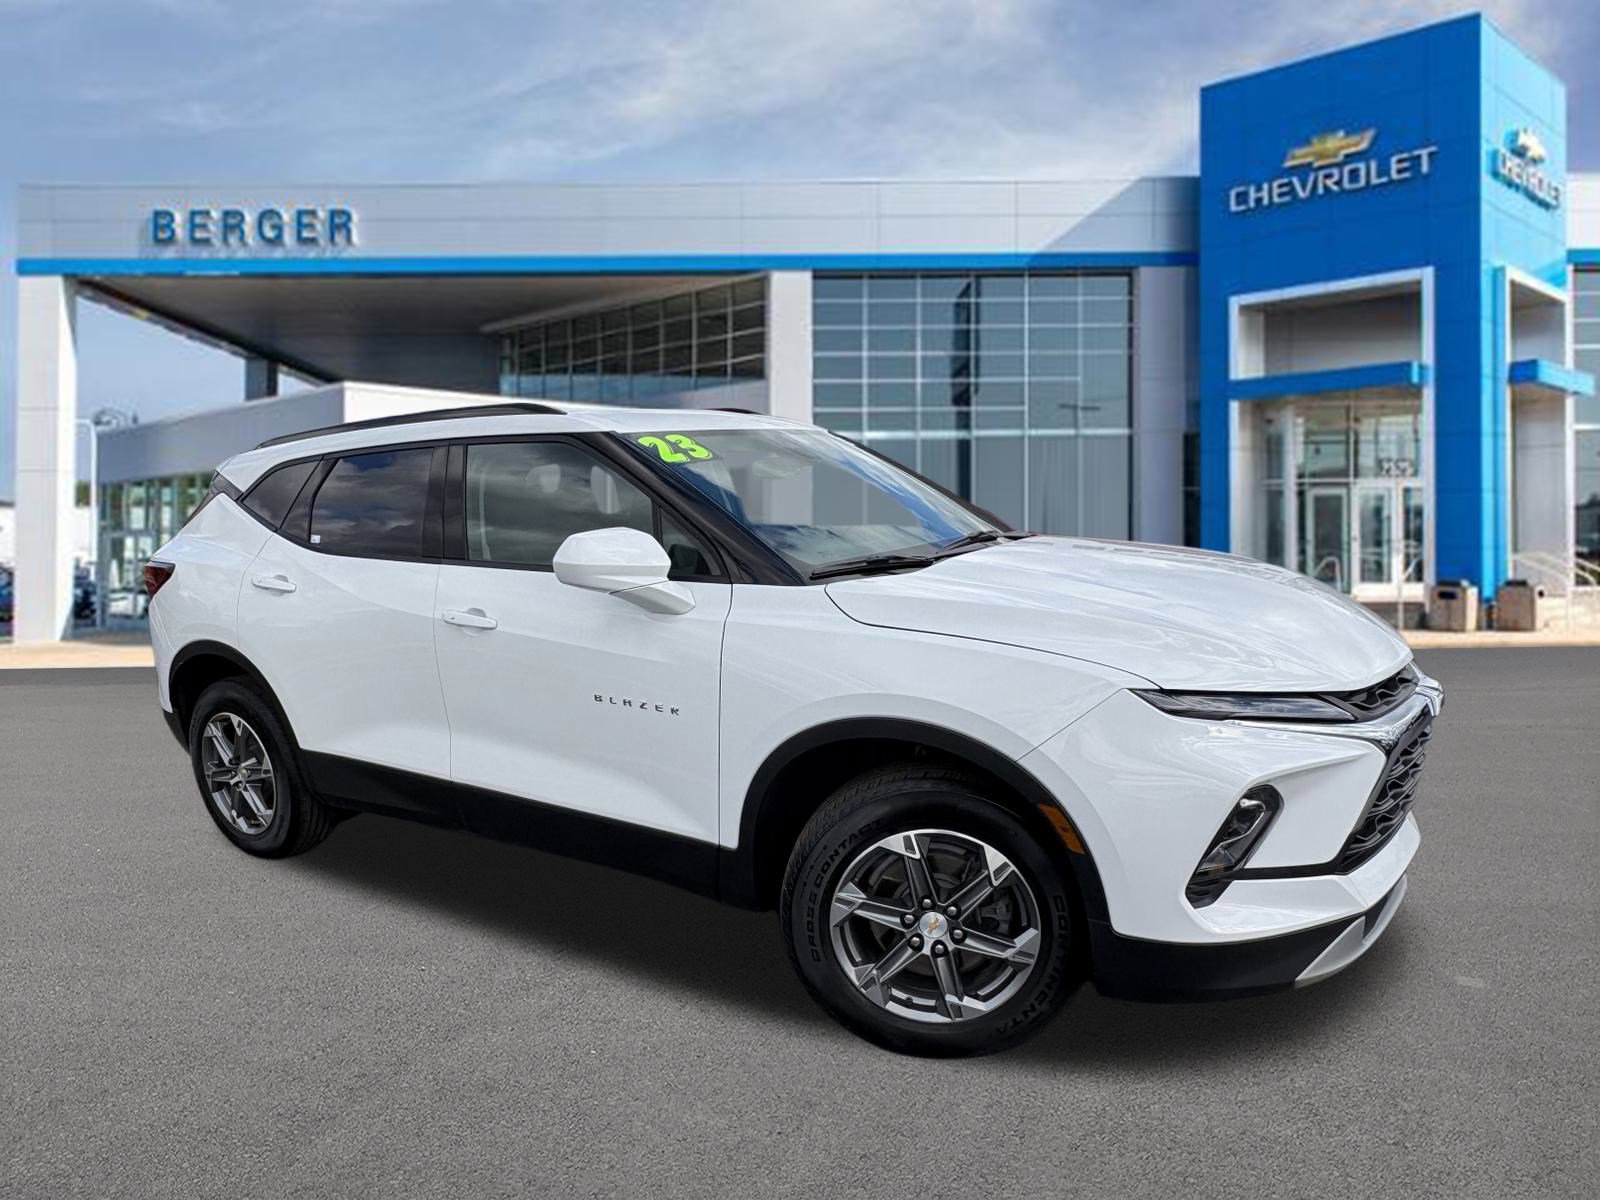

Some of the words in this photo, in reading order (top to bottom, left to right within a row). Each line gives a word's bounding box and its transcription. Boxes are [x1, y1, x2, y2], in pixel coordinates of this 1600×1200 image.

[1228, 146, 1438, 212] CHEVROLET
[152, 208, 354, 245] BERGER
[637, 433, 713, 463] 23
[593, 693, 680, 716] BLAZER
[805, 893, 821, 963] CROSS
[814, 818, 885, 889] CONTACT
